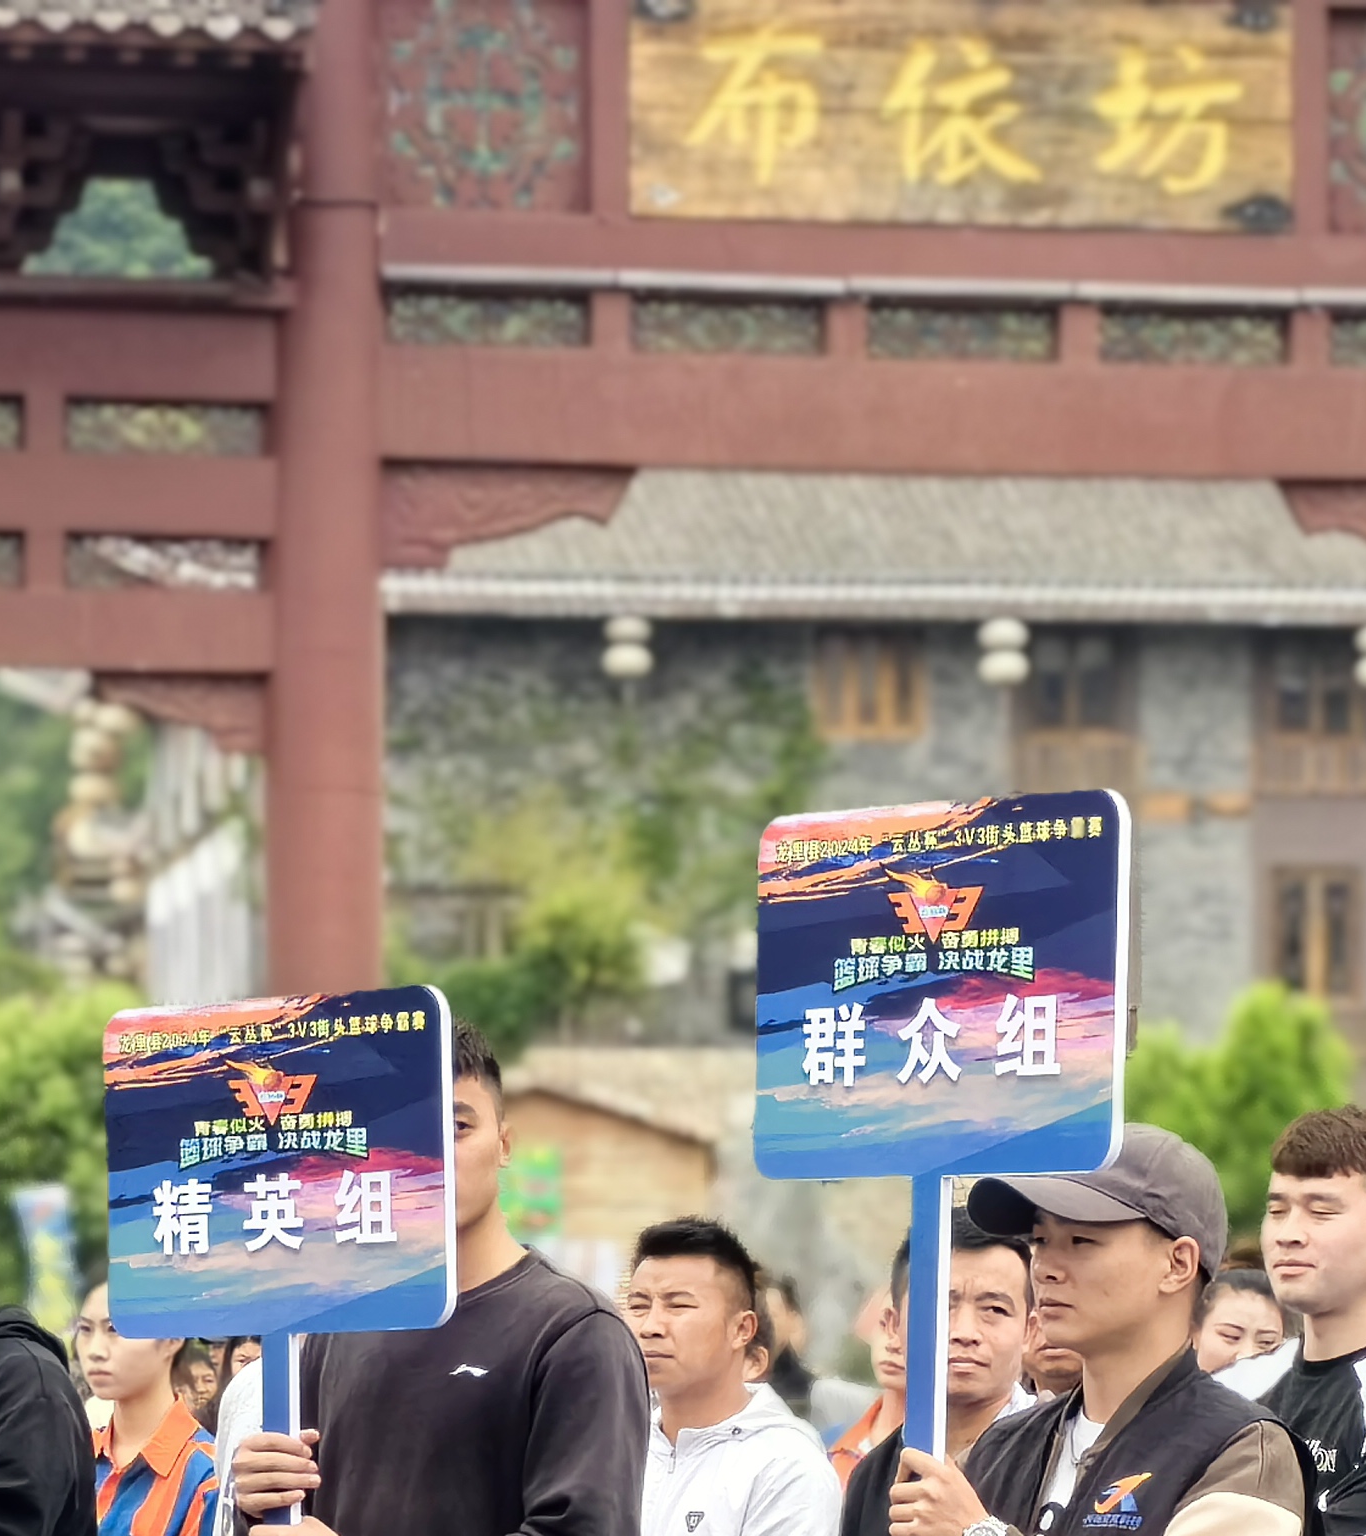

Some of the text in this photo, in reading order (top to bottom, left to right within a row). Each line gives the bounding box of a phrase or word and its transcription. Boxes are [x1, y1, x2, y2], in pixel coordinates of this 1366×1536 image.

[685, 25, 1243, 192] 布依坊
[938, 947, 1035, 981] 决战龙里
[802, 994, 1061, 1087] 群众组
[278, 1127, 369, 1159] 决战龙里
[153, 1170, 398, 1255] 精英组
